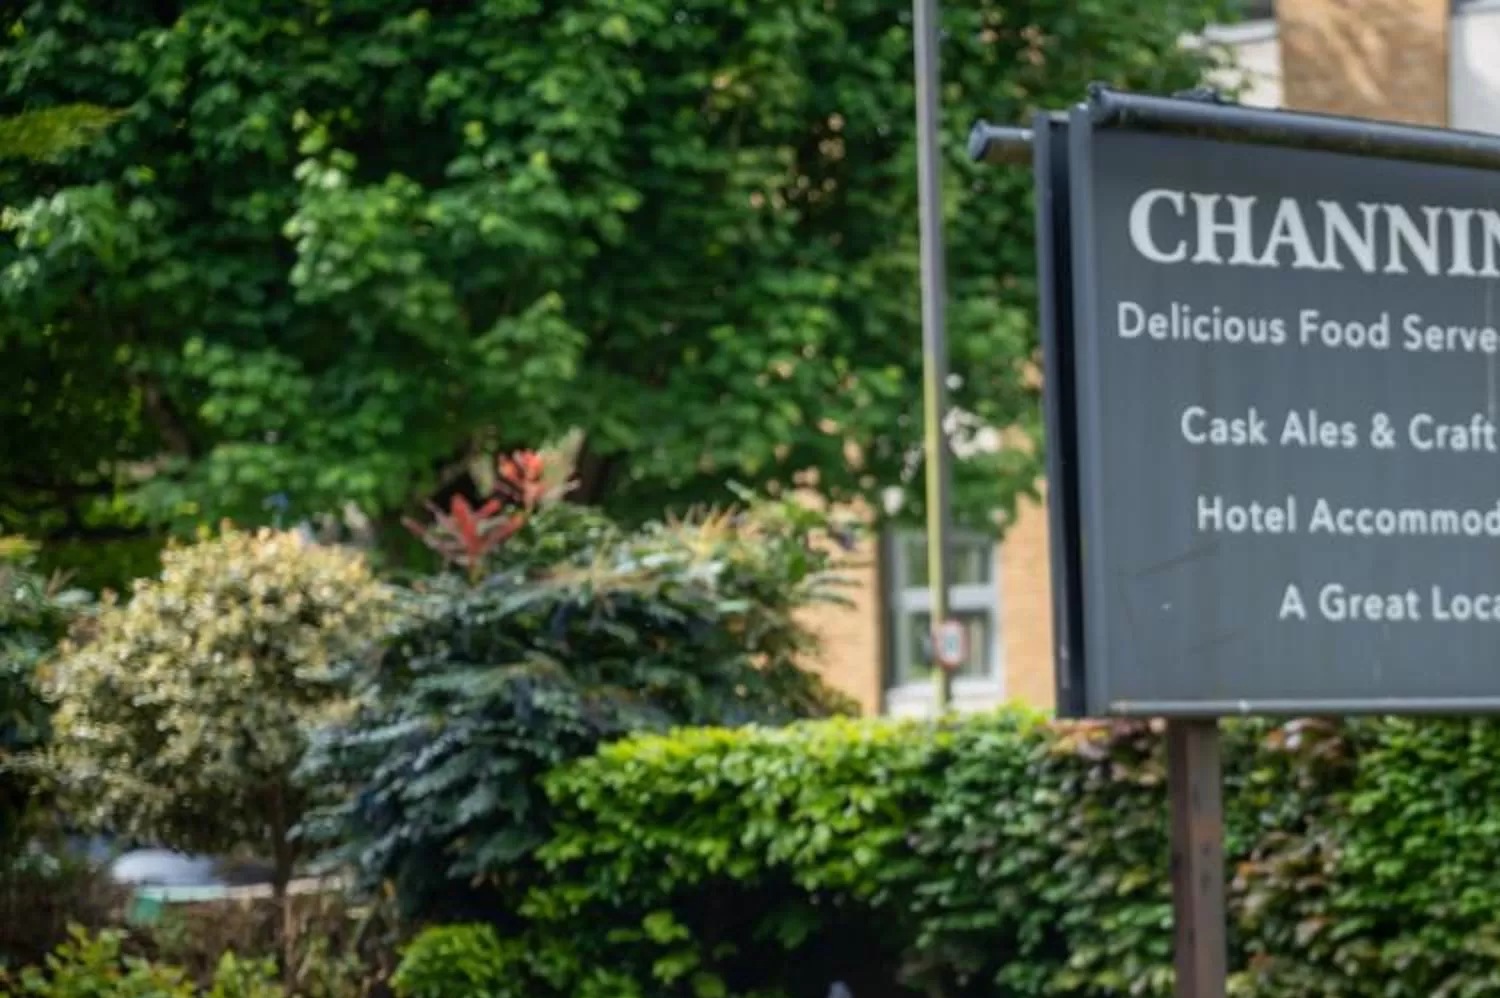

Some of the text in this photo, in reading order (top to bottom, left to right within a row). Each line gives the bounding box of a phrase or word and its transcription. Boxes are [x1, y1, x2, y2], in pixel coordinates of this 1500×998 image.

[1117, 301, 1287, 345] Delicious
[1299, 309, 1390, 349] Food
[1181, 406, 1268, 446] Cask
[1280, 409, 1358, 449] Ales
[1370, 412, 1396, 449] &
[1408, 413, 1496, 453] Craft
[1197, 495, 1296, 534] Hotel
[1279, 583, 1307, 620] A
[1318, 583, 1421, 621] Great
